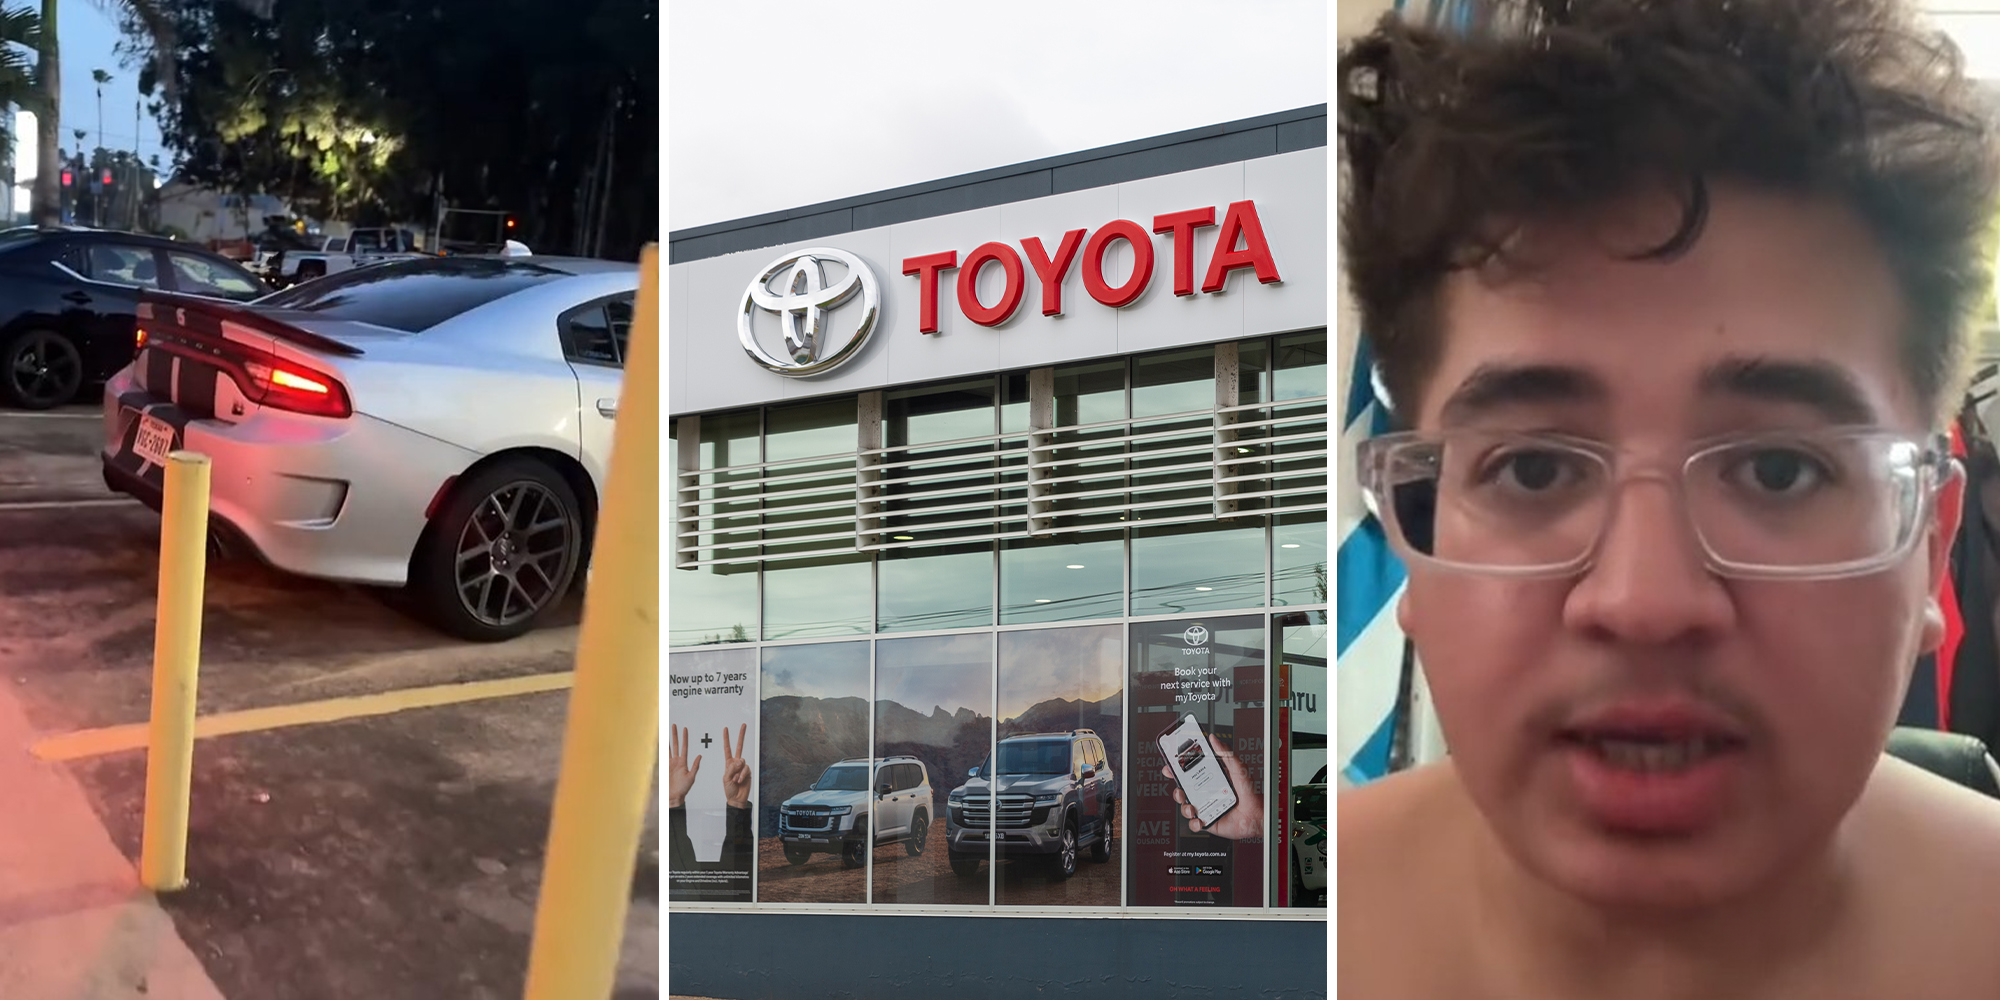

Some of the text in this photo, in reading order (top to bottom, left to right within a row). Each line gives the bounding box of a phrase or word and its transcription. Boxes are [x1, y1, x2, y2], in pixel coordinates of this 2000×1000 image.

[902, 199, 1284, 336] TOYOTA
[1181, 647, 1210, 655] TOYOTA
[669, 671, 747, 685] Now up to 7 years
[1174, 666, 1217, 677] Book your
[1160, 681, 1180, 690] next
[1180, 679, 1210, 689] service
[1212, 677, 1231, 687] with
[672, 684, 744, 699] engine warranty
[1175, 692, 1216, 703] myToyota
[1138, 821, 1170, 836] AVE
